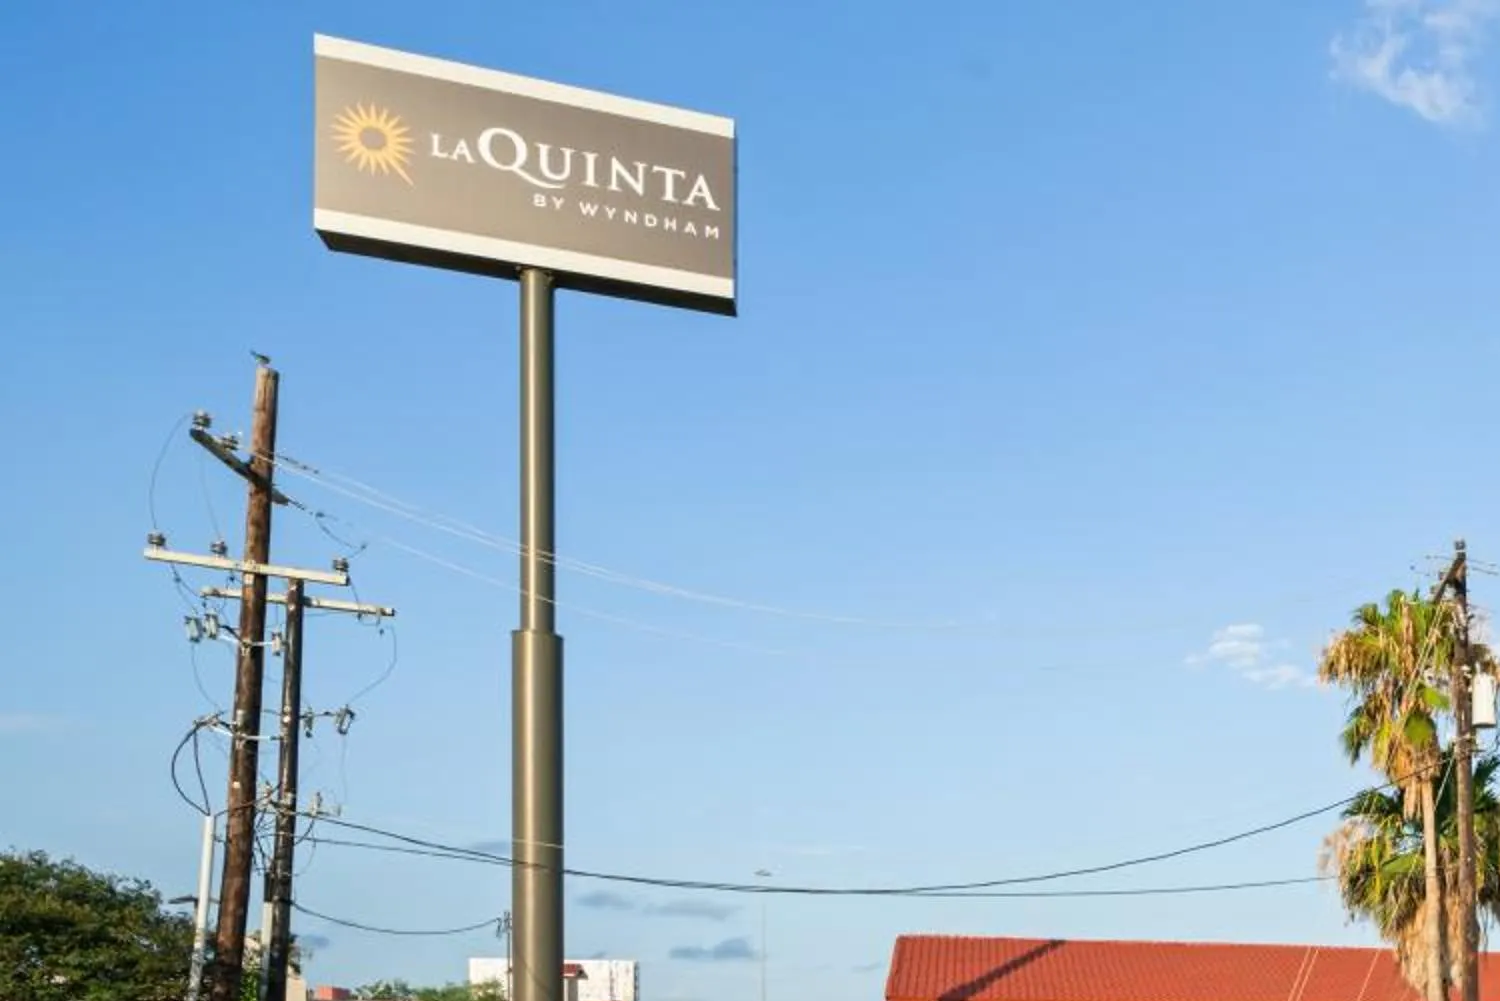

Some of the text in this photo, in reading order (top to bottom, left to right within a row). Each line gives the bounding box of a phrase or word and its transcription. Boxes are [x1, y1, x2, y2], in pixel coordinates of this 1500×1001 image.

[430, 127, 721, 211] LA QUINTA
[533, 193, 720, 239] BY WYNDHAM
